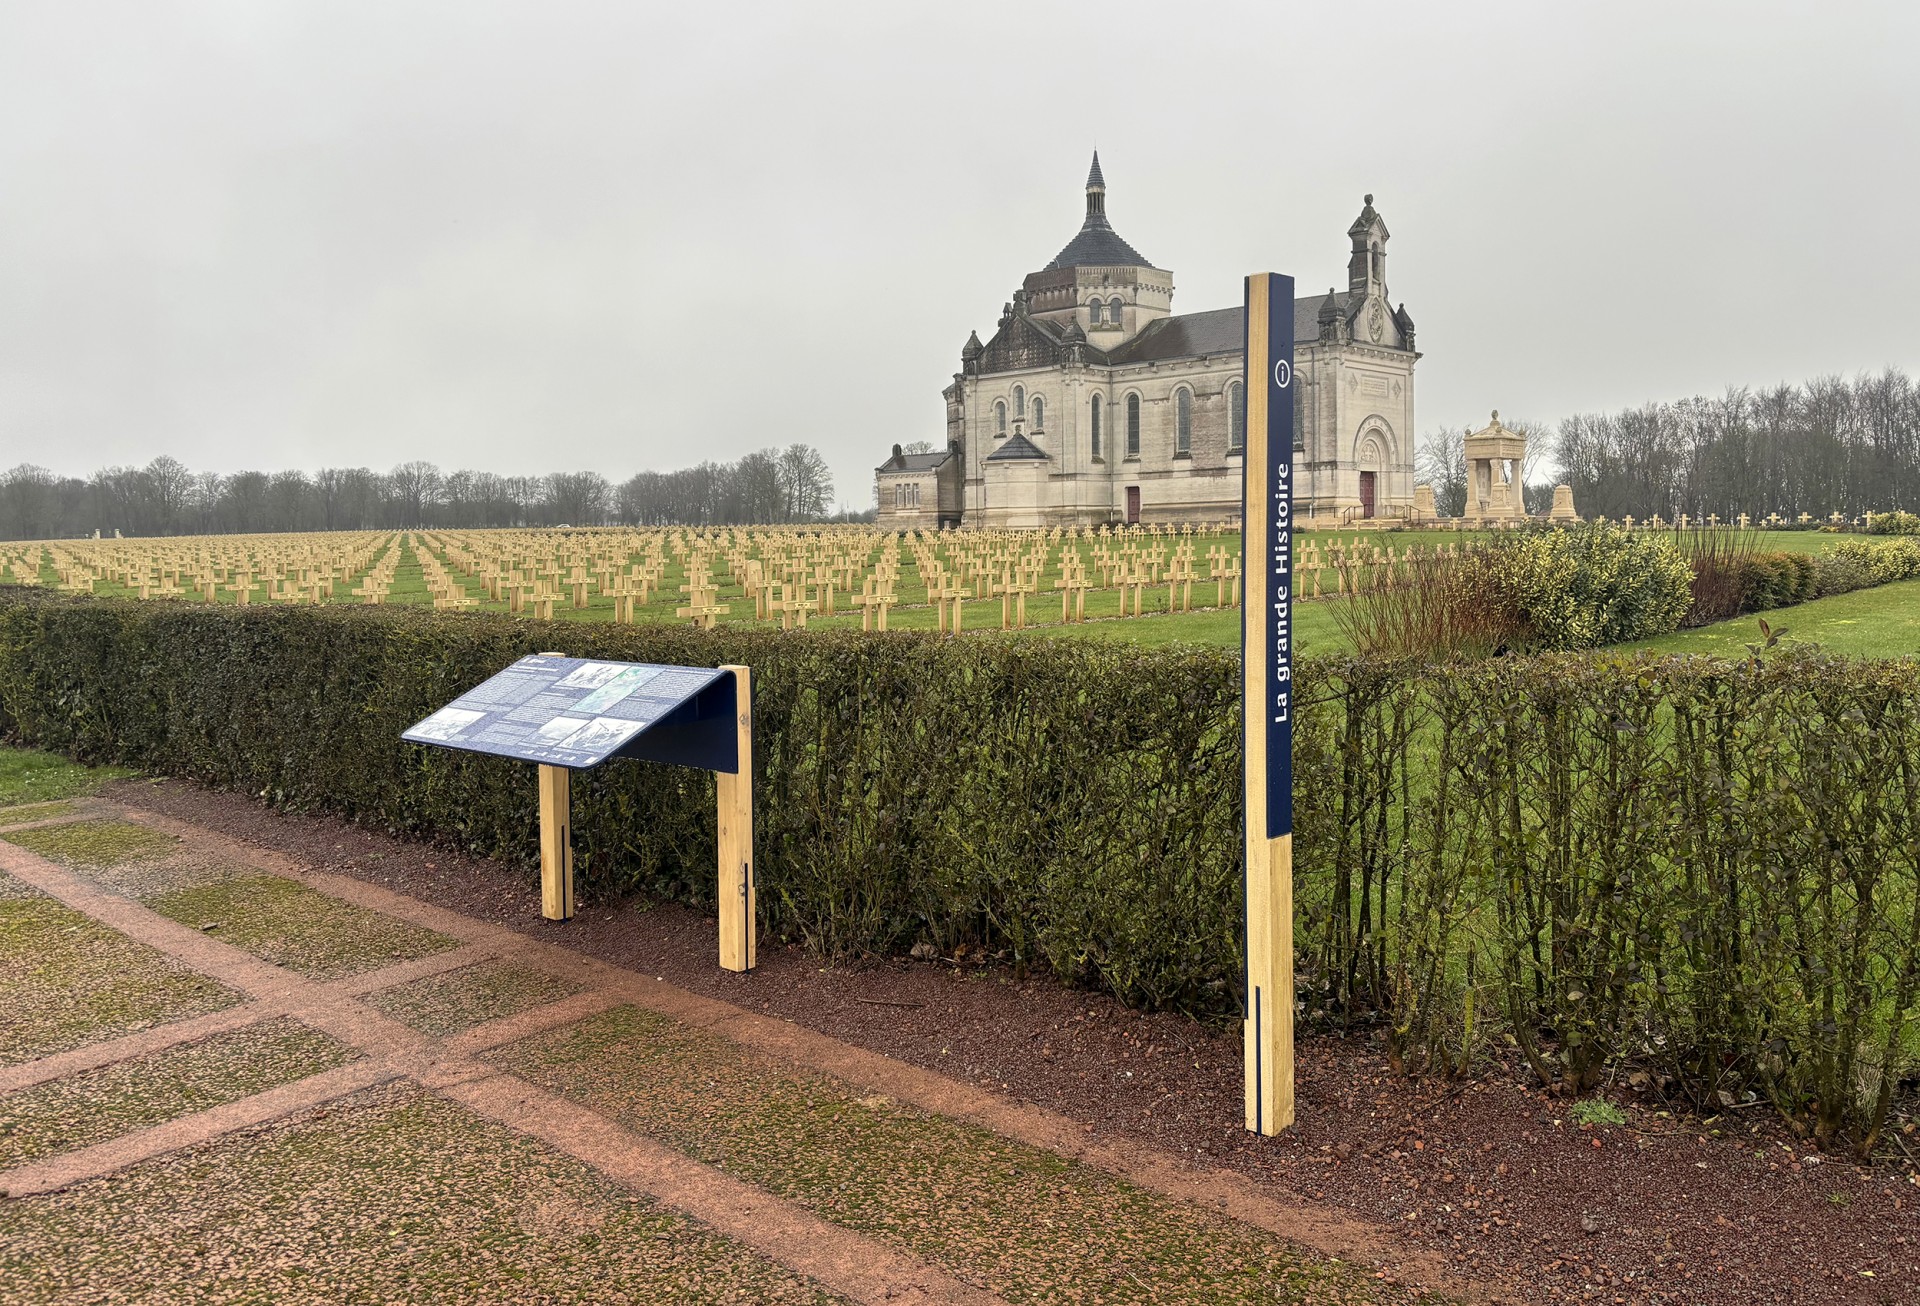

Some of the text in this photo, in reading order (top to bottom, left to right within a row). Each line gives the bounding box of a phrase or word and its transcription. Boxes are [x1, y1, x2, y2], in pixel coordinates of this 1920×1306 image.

[1274, 463, 1291, 723] La grande Histoire
